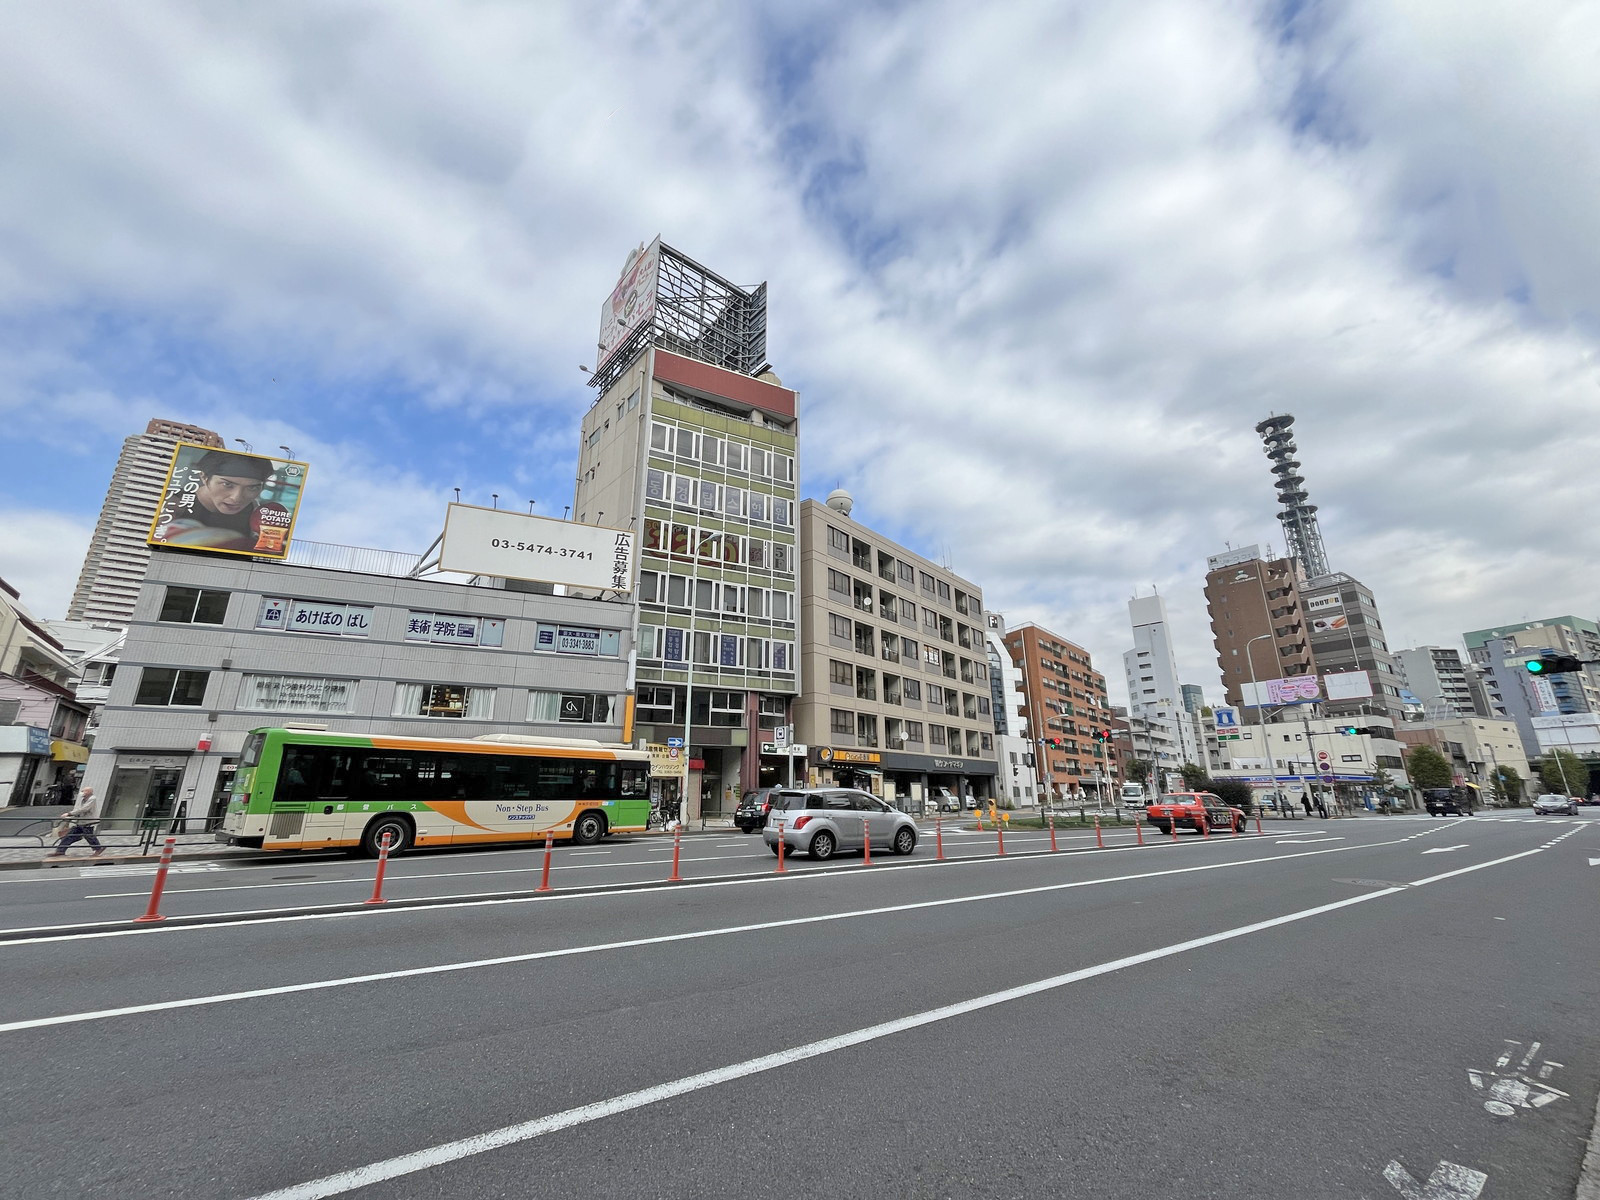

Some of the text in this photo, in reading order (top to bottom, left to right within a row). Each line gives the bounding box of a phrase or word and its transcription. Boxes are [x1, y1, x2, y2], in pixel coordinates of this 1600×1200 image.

[178, 470, 202, 514] この男、
[154, 466, 188, 543] ピュアにつき。
[261, 514, 290, 524] POTATO
[270, 510, 292, 518] PURE
[491, 538, 594, 560] 03-5474-3741
[611, 533, 631, 590] 広告募集
[1310, 597, 1340, 608] DOUTOR
[408, 618, 456, 636] 美術学院
[536, 804, 549, 812] Bus
